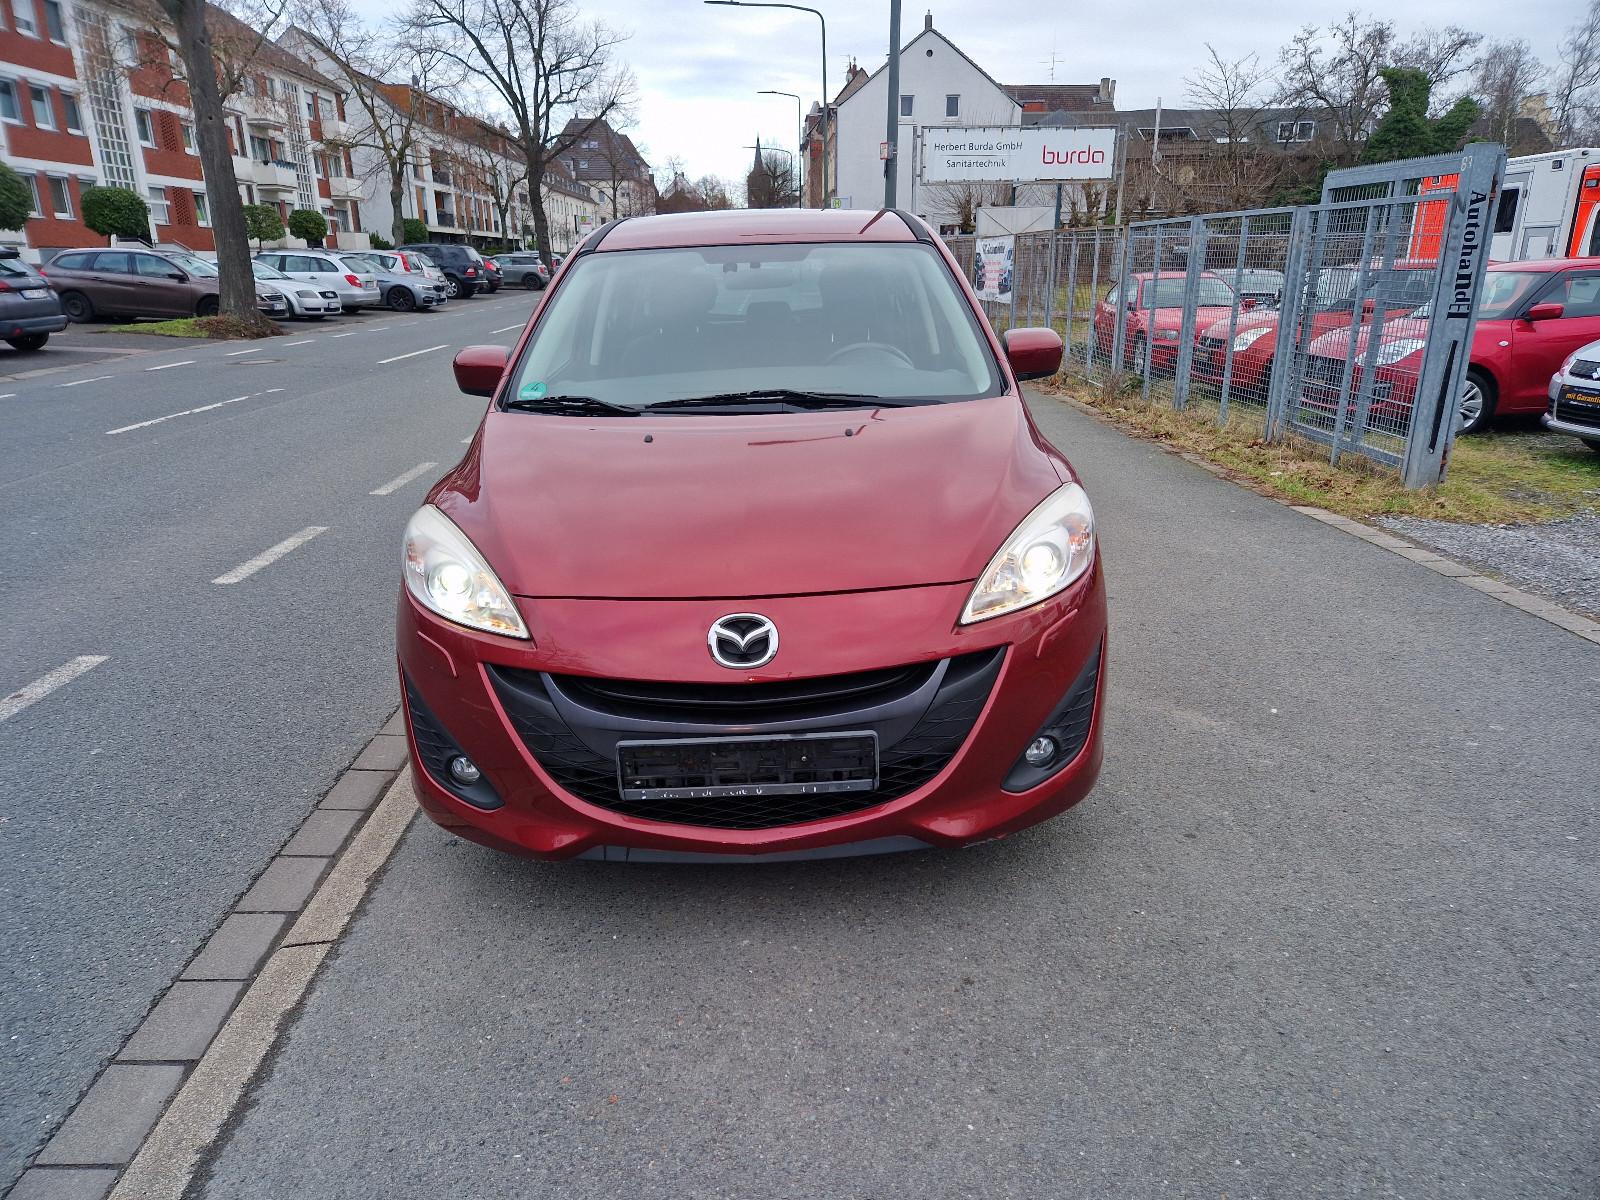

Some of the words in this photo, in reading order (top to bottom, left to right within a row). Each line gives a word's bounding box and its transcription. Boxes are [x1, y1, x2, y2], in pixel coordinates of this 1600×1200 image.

[934, 142, 966, 151] Herbert
[968, 142, 994, 151] Burda
[996, 141, 1023, 151] GmbH
[1042, 144, 1105, 165] burda
[946, 159, 1006, 168] Sanitärtechnik
